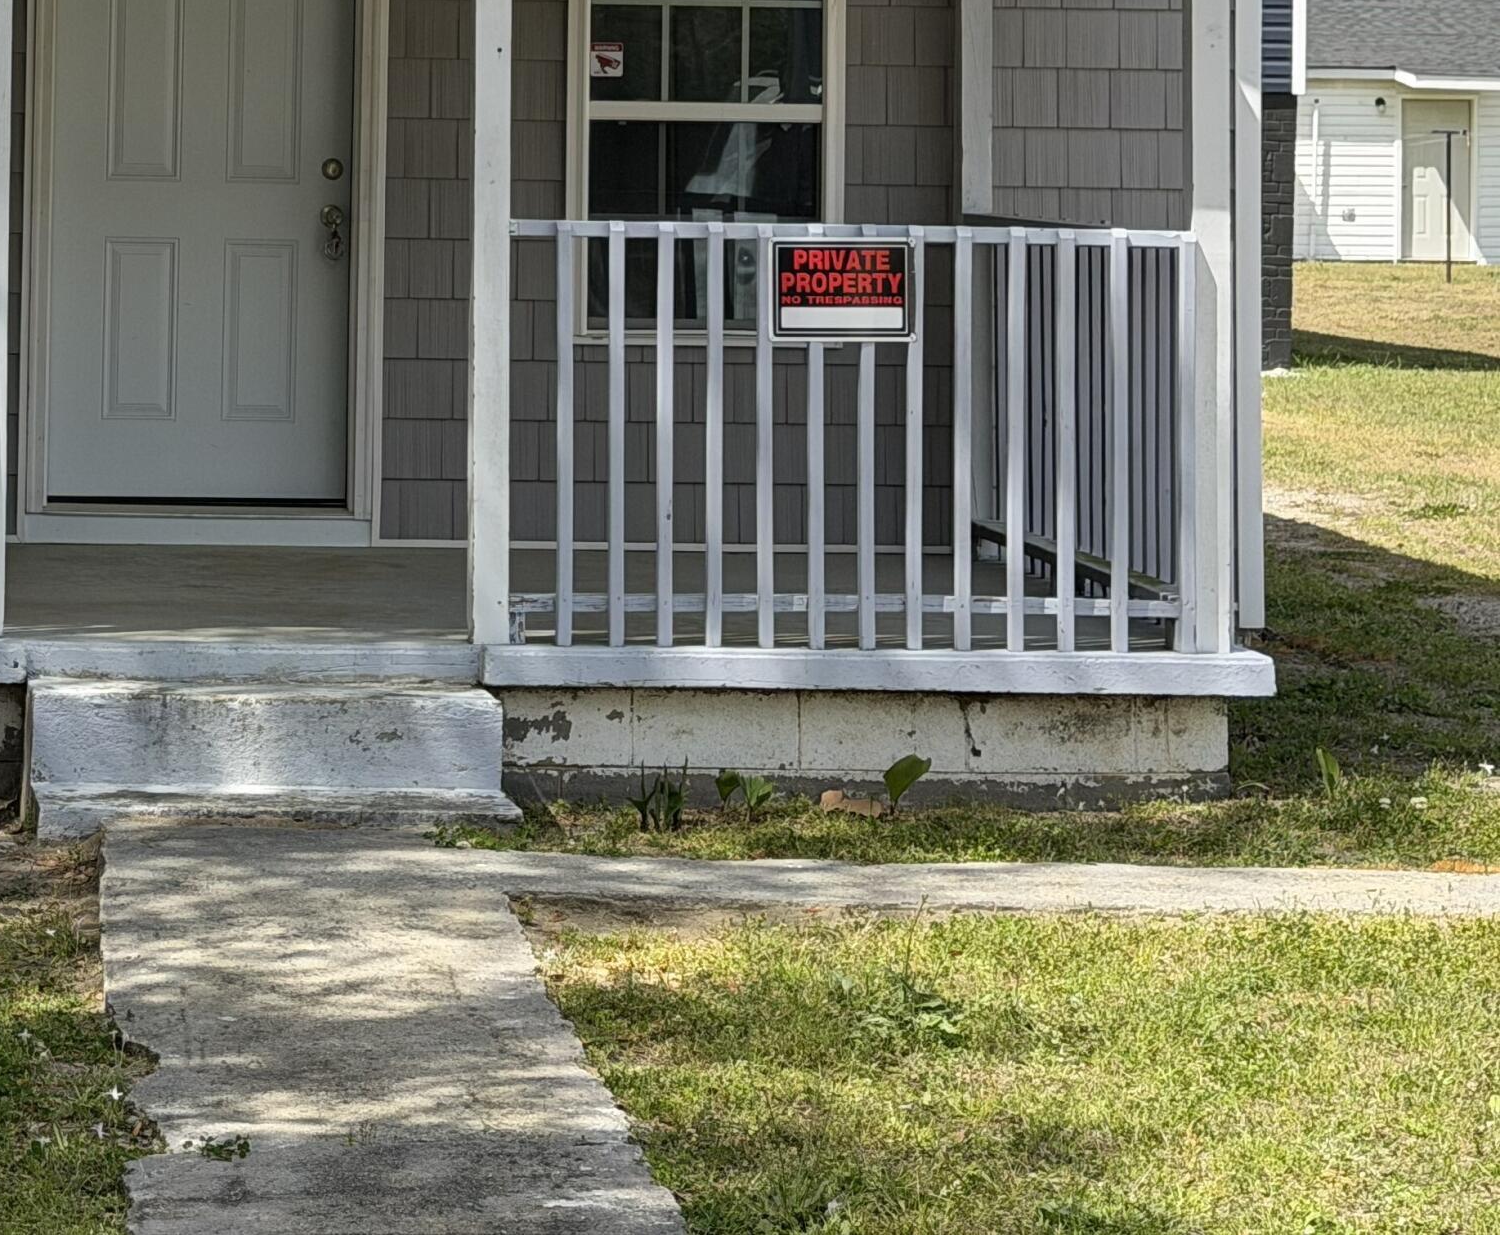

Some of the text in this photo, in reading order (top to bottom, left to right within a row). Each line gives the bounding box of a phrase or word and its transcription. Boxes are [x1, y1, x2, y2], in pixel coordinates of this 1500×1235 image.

[793, 249, 890, 271] PRIVATE
[781, 272, 903, 294] PROPERTY
[781, 296, 903, 305] NO TRESPASSING
